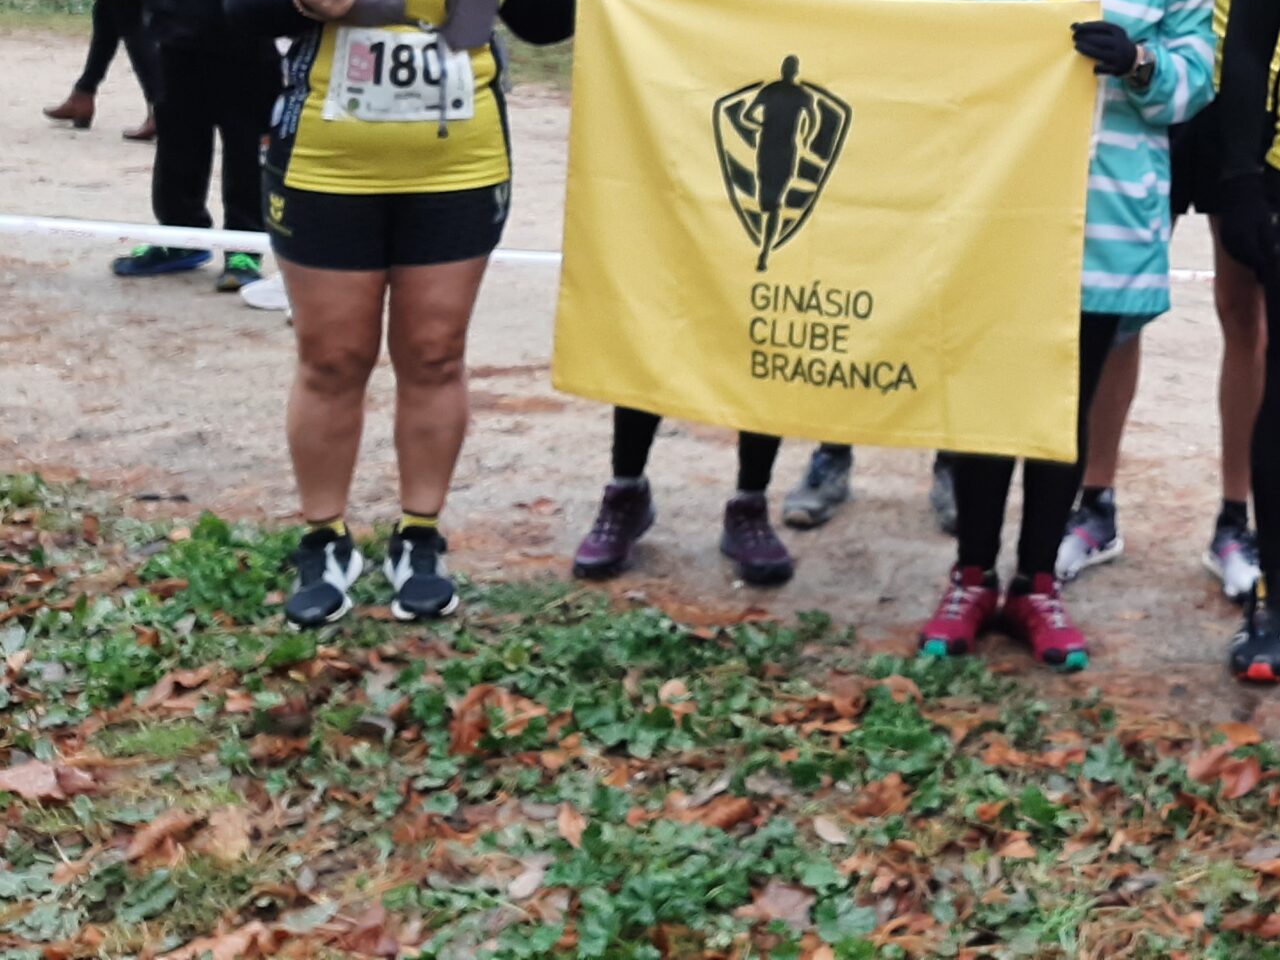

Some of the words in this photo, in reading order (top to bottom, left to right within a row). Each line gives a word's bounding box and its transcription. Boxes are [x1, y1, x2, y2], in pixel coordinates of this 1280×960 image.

[370, 42, 443, 88] 180
[751, 280, 874, 320] GINÁSIO
[749, 316, 850, 354] CLUBE
[751, 350, 917, 396] BRAGANÇA
